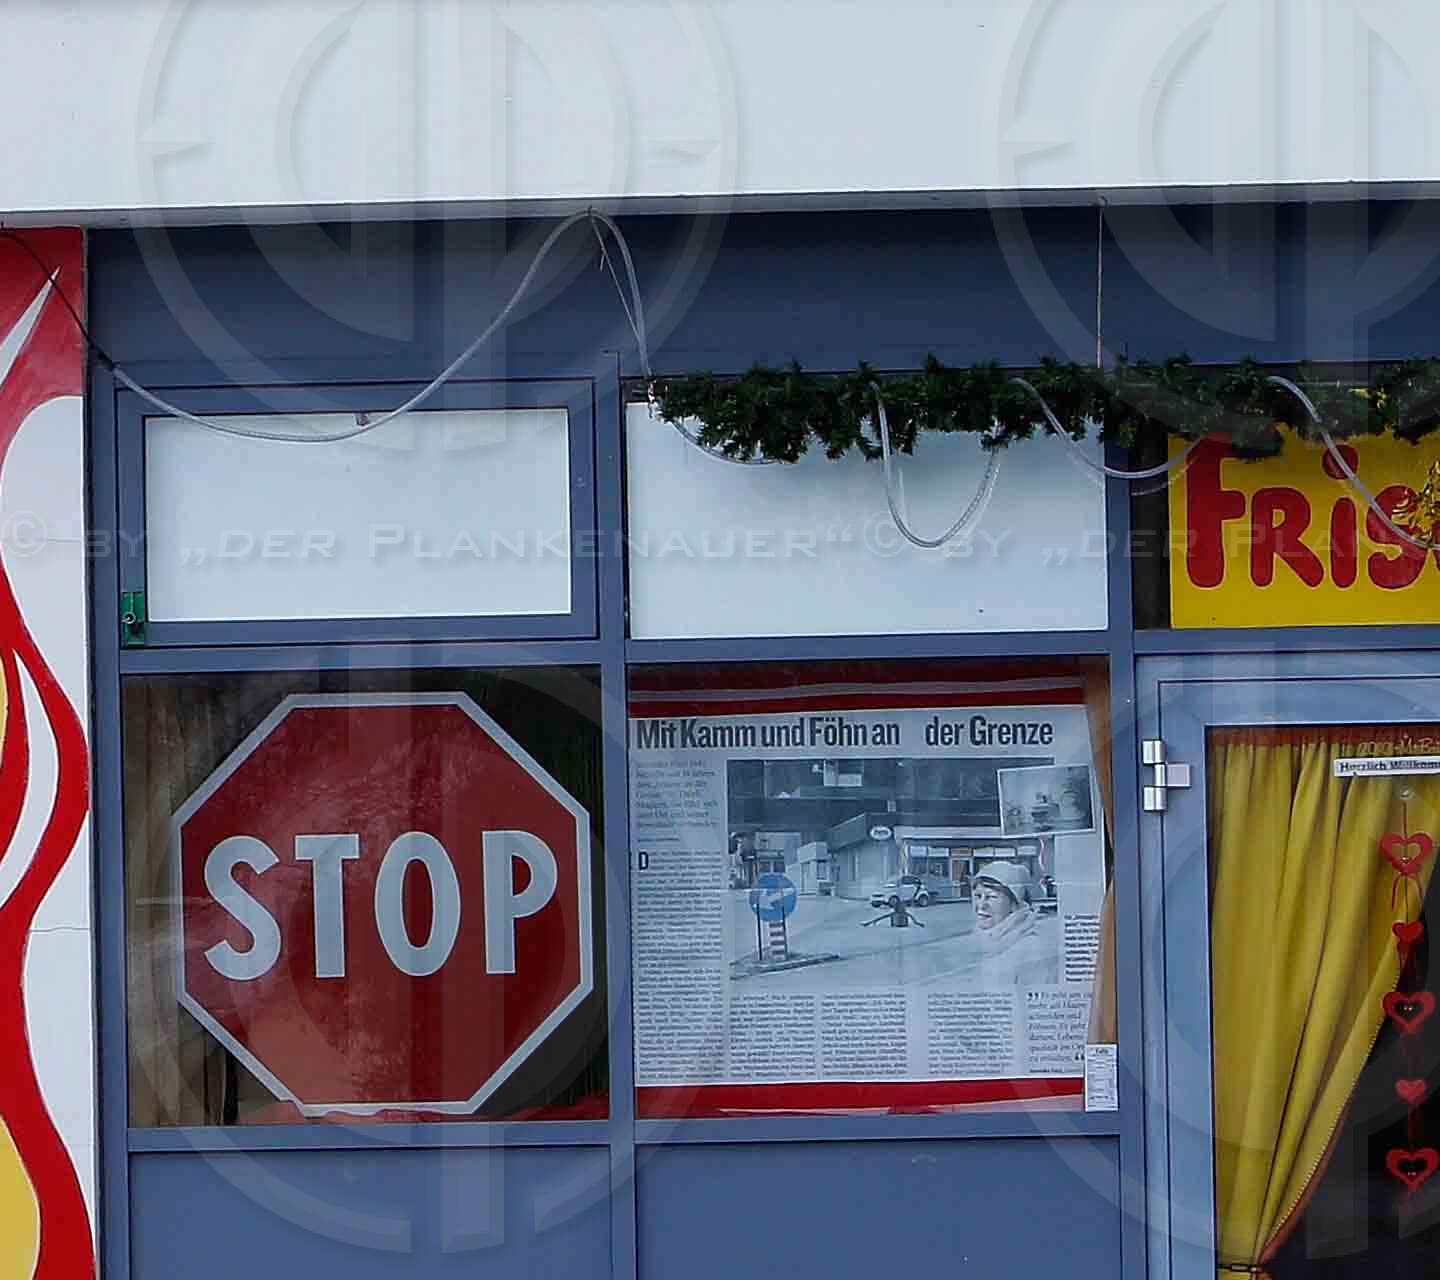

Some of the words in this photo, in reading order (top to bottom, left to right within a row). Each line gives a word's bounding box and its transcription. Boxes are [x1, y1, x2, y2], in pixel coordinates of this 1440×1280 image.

[637, 720, 677, 750] Mit
[680, 718, 756, 749] Kamm
[761, 716, 805, 748] und
[809, 715, 868, 747] Föhn
[872, 722, 900, 746] an
[925, 715, 965, 746] der
[970, 715, 1054, 746] Grenze
[202, 829, 559, 982] STOP
